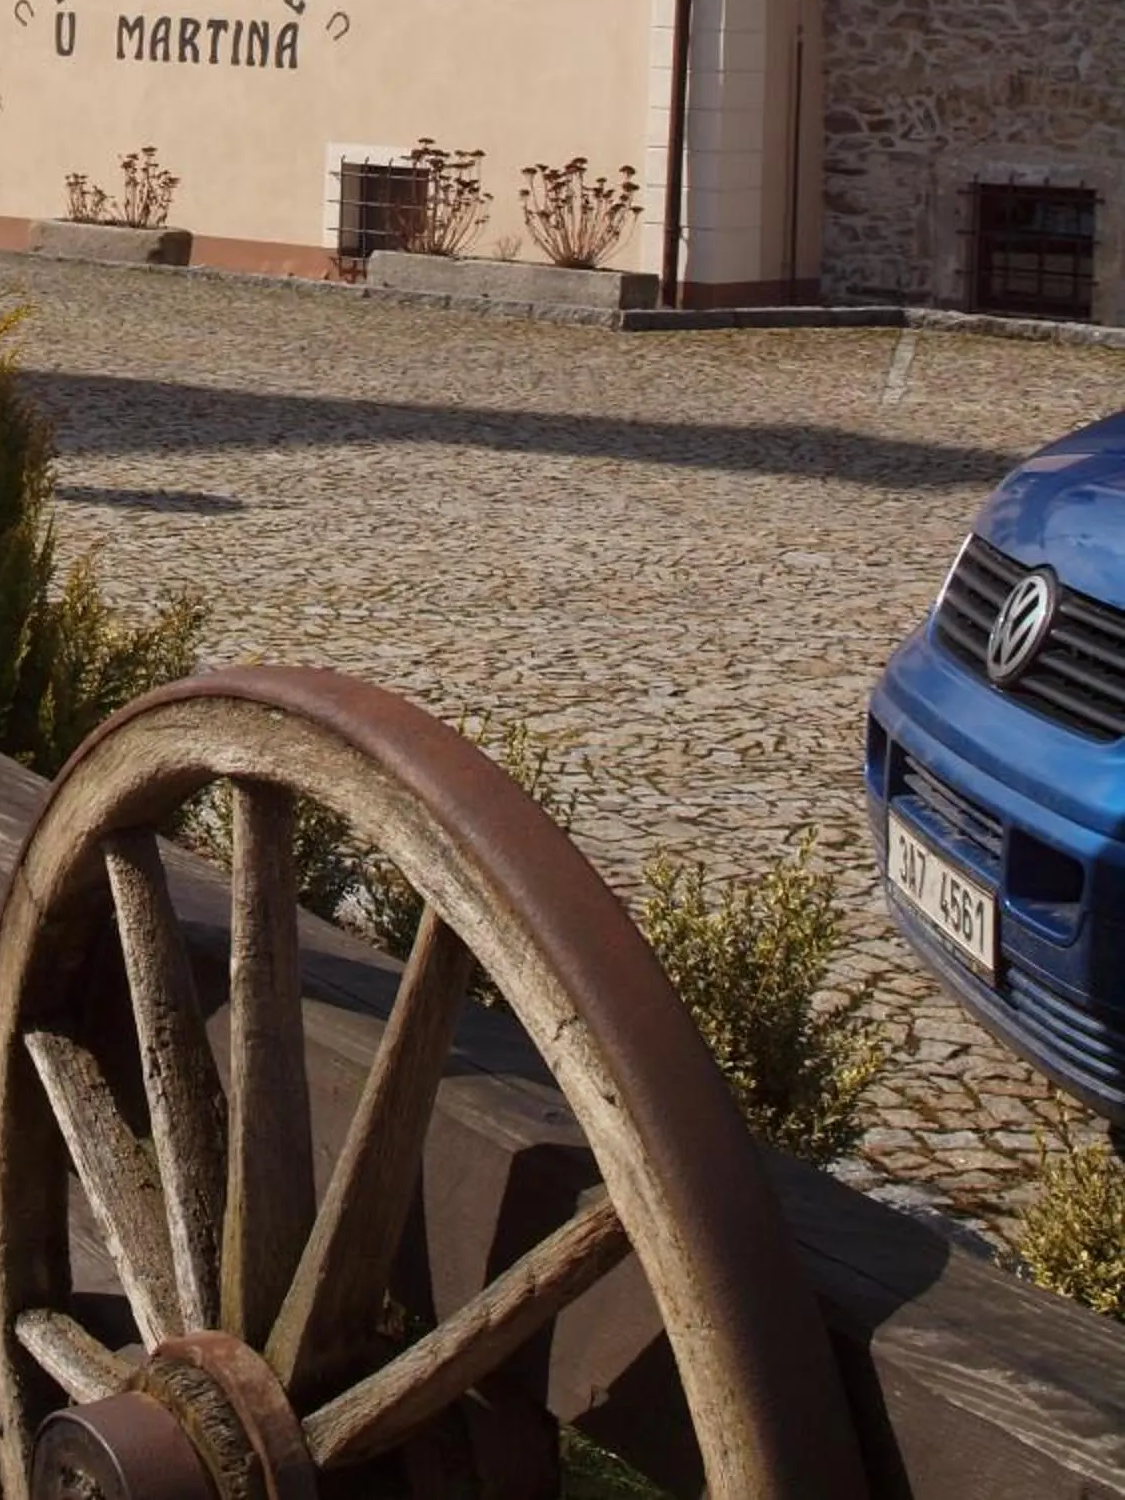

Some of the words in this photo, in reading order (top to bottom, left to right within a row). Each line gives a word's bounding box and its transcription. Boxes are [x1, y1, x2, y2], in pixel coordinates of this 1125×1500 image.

[55, 11, 75, 57] U
[116, 15, 300, 68] MARTINA
[940, 872, 984, 953] 4561
